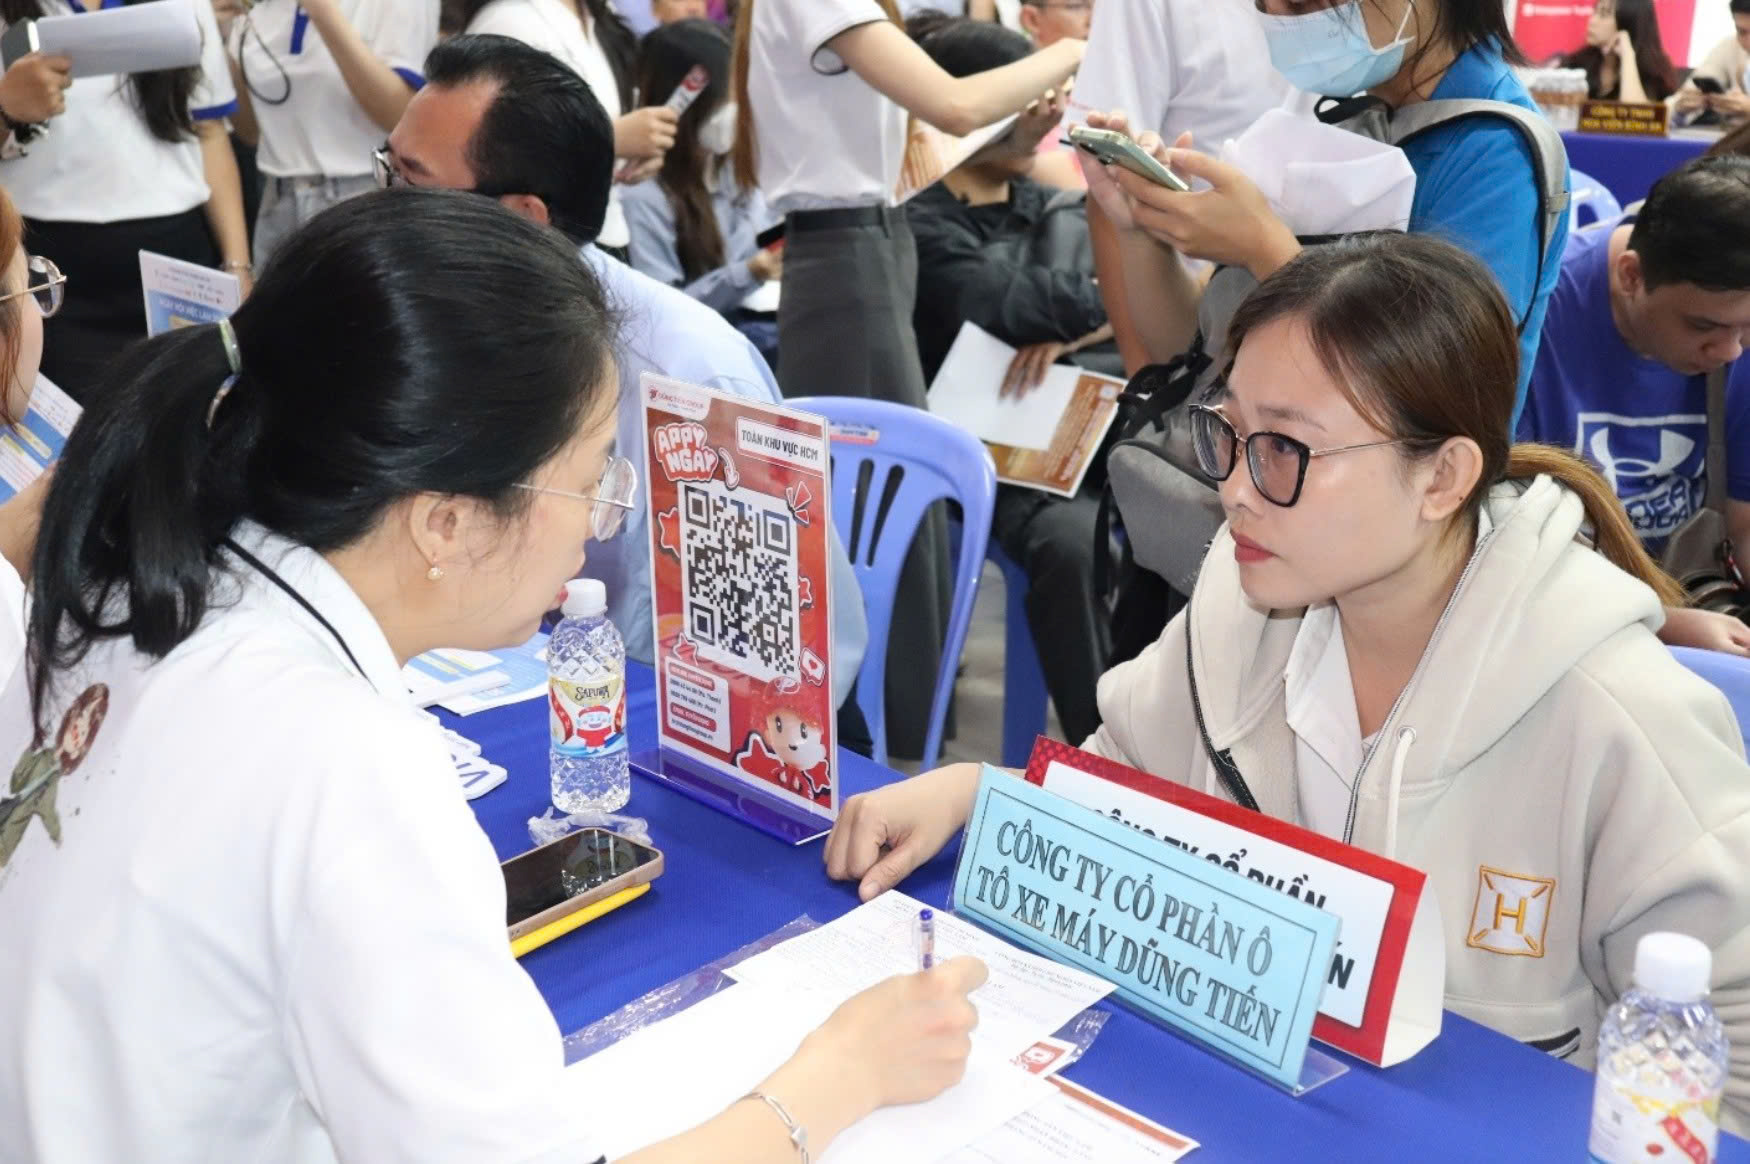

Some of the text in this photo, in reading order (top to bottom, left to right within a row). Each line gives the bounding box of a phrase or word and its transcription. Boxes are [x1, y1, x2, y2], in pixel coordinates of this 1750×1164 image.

[665, 449, 717, 473] NGAY
[741, 428, 819, 461] TOÀN KHU VỰC HCM
[997, 818, 1071, 882] CÔNG
[1073, 854, 1114, 902] TY
[1113, 873, 1155, 922] CỔ
[1156, 893, 1246, 965] PHẦN
[1247, 925, 1273, 977] Ô
[1493, 893, 1527, 935] H
[976, 865, 1011, 911] TÔ
[1011, 884, 1050, 932] XE
[1050, 903, 1118, 964] MÁY
[1114, 935, 1201, 1007] DŨNG
[1204, 977, 1282, 1047] TIẾN
